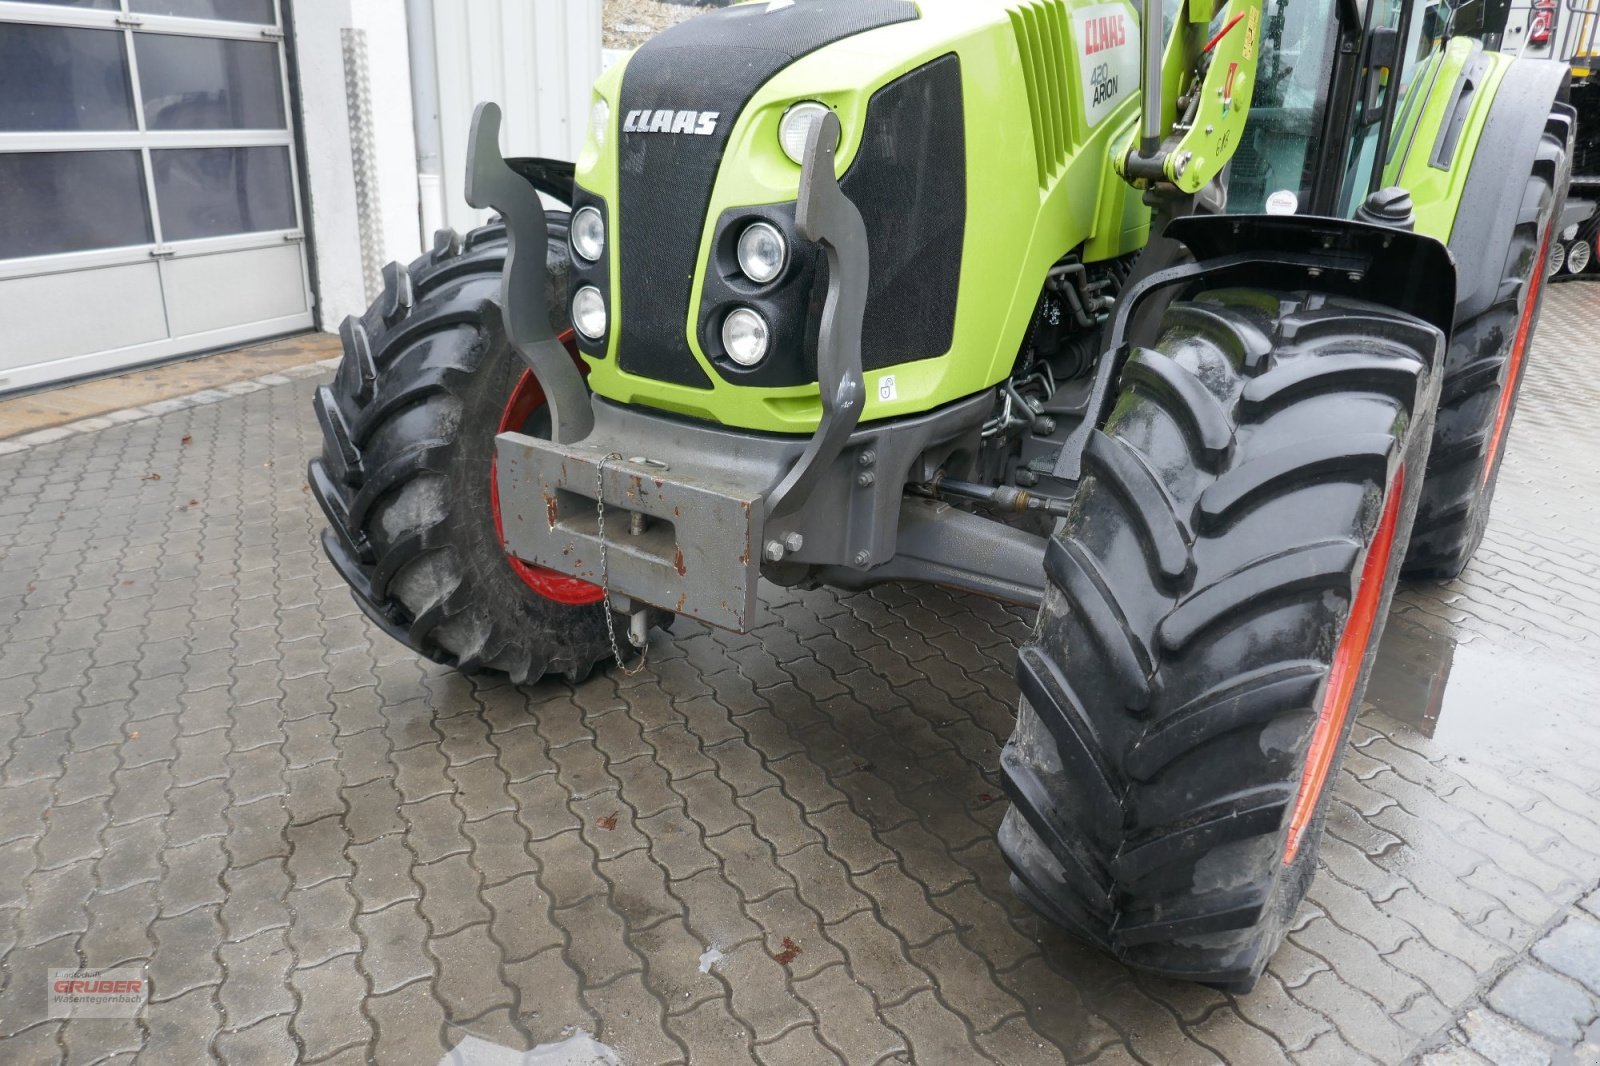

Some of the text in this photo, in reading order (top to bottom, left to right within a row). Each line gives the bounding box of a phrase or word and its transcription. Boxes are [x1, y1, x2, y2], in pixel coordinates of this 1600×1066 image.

[1085, 15, 1125, 55] CLAAS
[1090, 62, 1109, 86] 420
[1092, 75, 1118, 108] ARION
[622, 108, 720, 135] CLAAS
